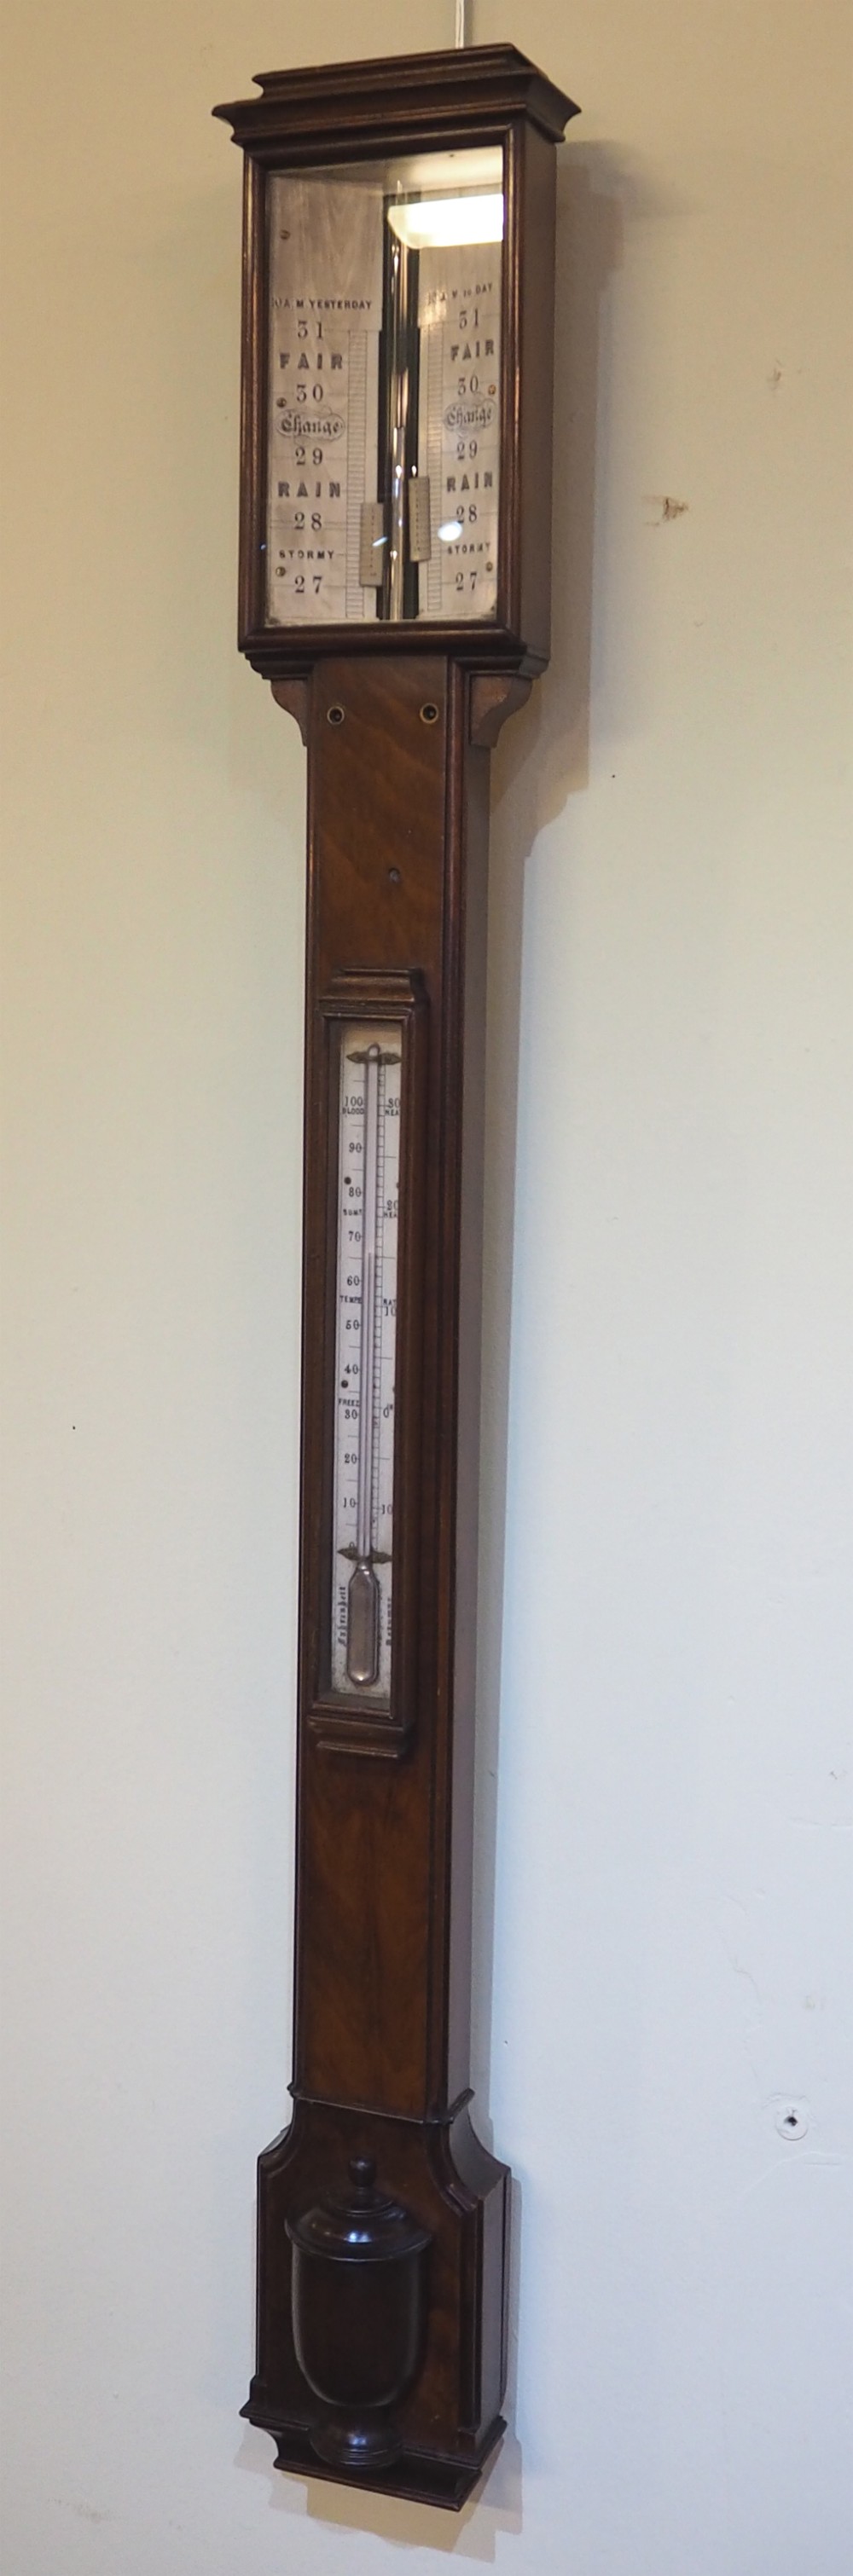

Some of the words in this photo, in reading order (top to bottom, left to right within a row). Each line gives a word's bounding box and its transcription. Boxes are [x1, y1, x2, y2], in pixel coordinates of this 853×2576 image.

[475, 282, 492, 295] DAY
[309, 298, 372, 310] YESTERDAY
[458, 309, 479, 329] 31
[297, 321, 323, 339] 31
[450, 339, 495, 362] FAIR
[279, 352, 343, 370] FAIR
[296, 384, 323, 402] 30
[457, 375, 479, 396] 30
[446, 404, 492, 427] Change
[280, 414, 340, 436] Change
[295, 446, 323, 466] 29
[456, 440, 478, 460] 29
[277, 481, 341, 498] RAIN
[446, 472, 493, 493] RAIN
[294, 512, 322, 530] 28
[456, 505, 478, 524] 28
[279, 550, 334, 559] STORMY
[447, 542, 491, 554] STORMY
[294, 575, 322, 593] 27
[456, 572, 478, 592] 27
[345, 1096, 363, 1107] 100
[349, 1143, 362, 1153] 90
[348, 1186, 362, 1197] 80
[348, 1231, 362, 1242] 70
[346, 1276, 360, 1286] 60
[344, 1363, 358, 1375] 40
[344, 1453, 357, 1464] 20
[343, 1497, 357, 1508] 10
